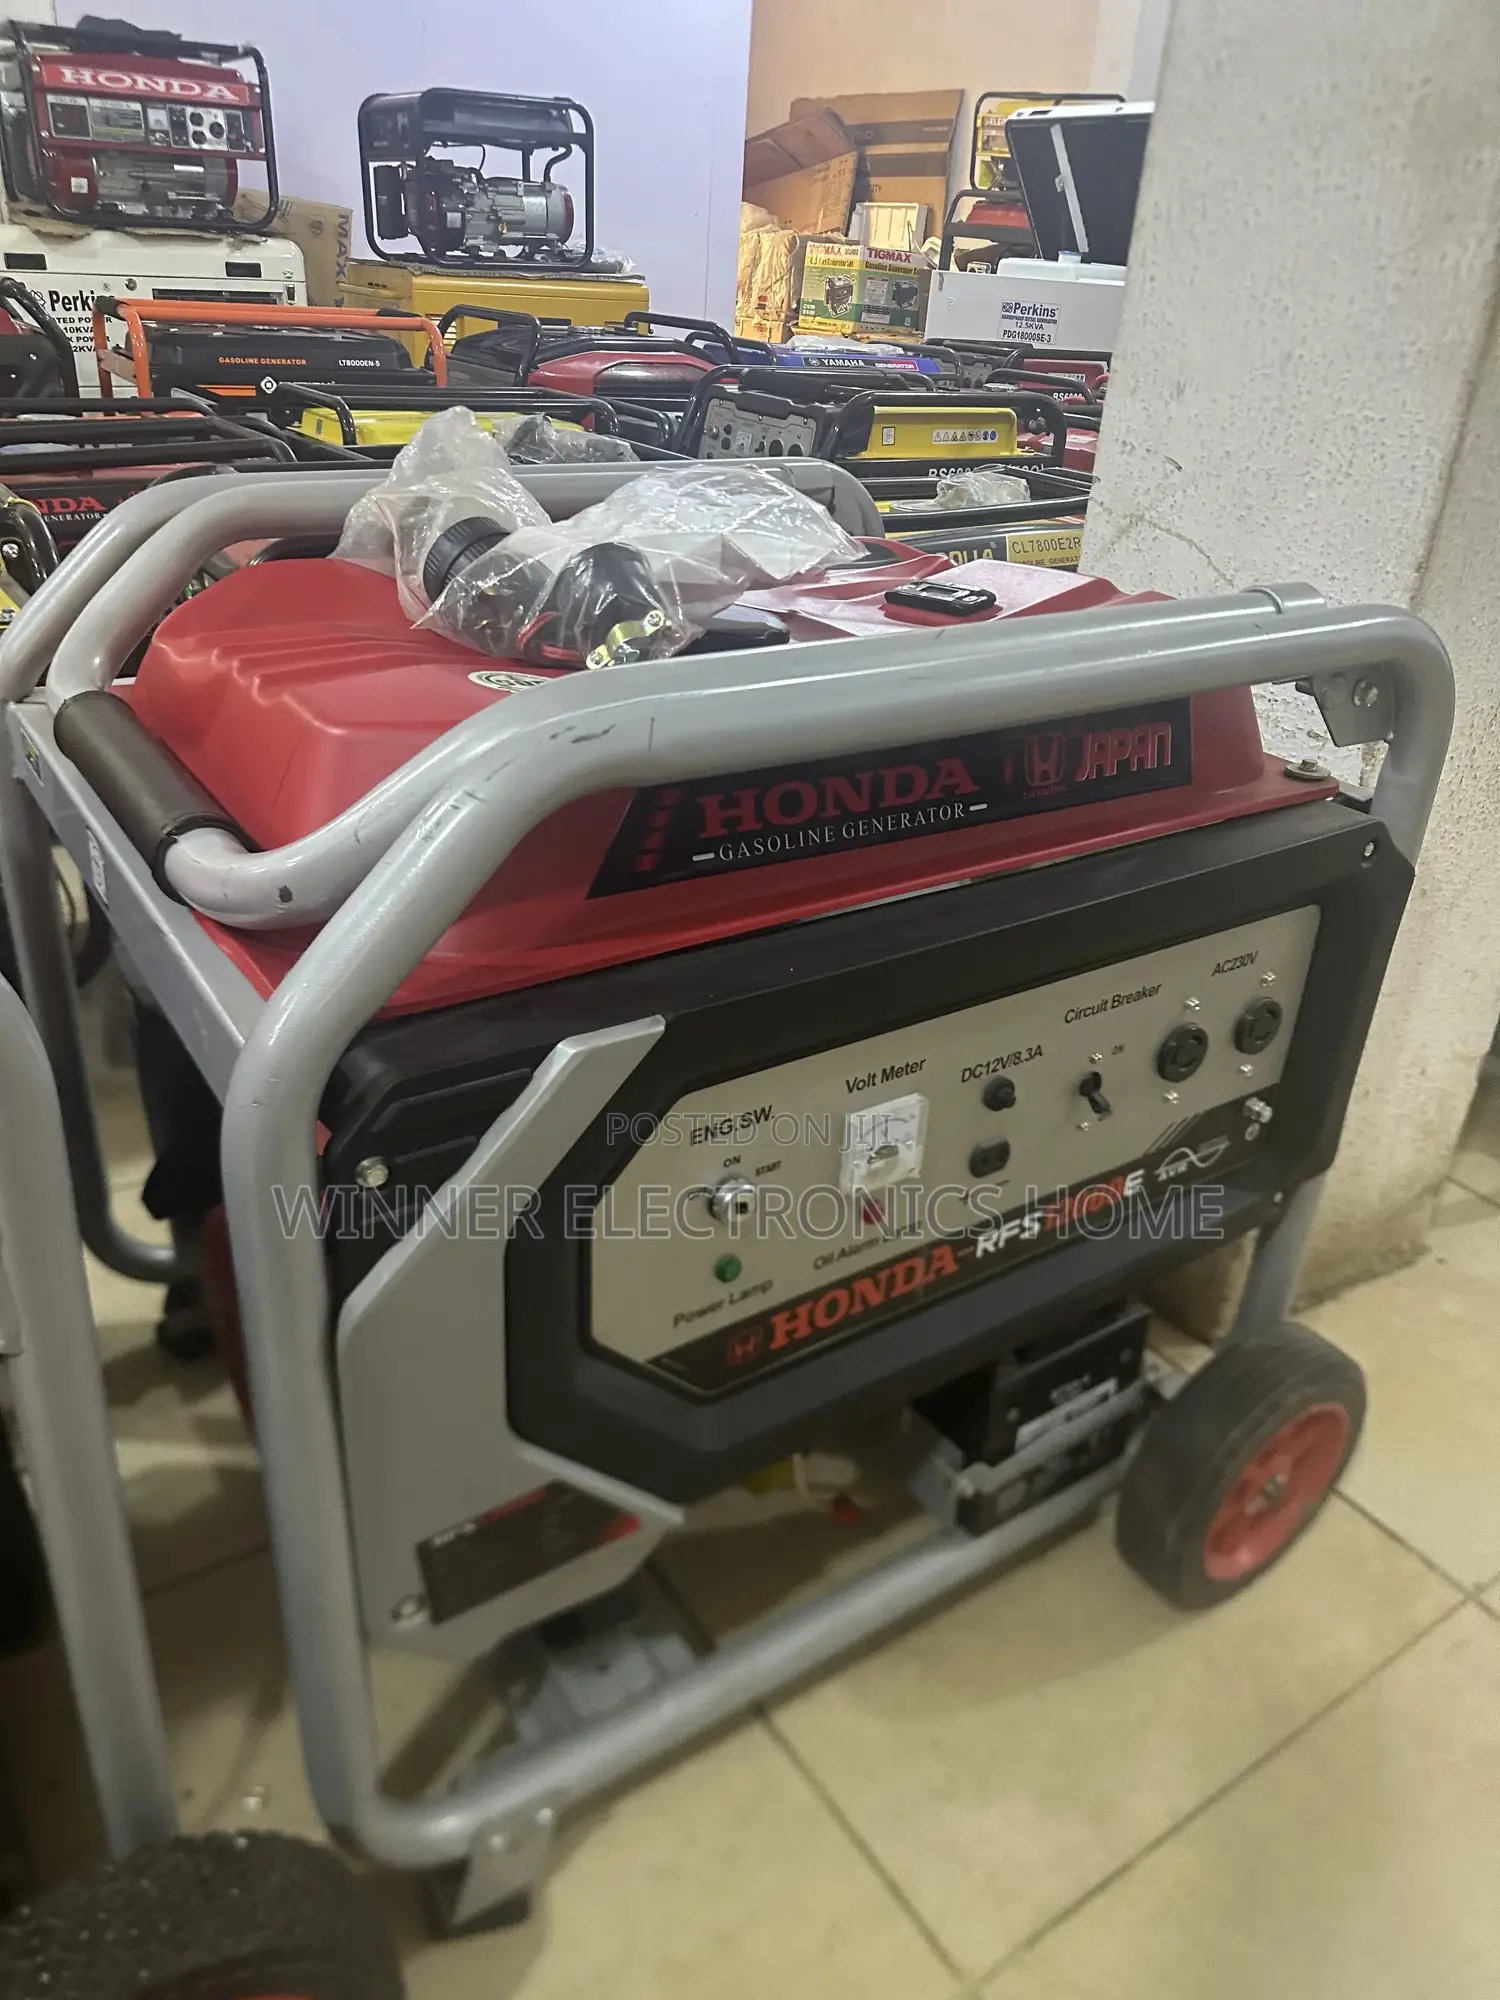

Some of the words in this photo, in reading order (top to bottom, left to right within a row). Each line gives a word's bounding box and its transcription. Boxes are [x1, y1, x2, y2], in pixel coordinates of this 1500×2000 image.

[60, 68, 240, 101] HONDA
[867, 247, 911, 263] TIGMAX
[1013, 302, 1056, 318] Perkins
[1002, 330, 1051, 342] PDG18000SE-3
[1075, 720, 1172, 782] JAPAN
[697, 756, 981, 839] HONDA
[718, 824, 836, 862] GASOLINE
[842, 802, 966, 840] GENERATOR
[1211, 950, 1260, 978] AC230V
[1064, 998, 1109, 1024] Circuit
[1110, 982, 1163, 1010] Breaker
[845, 1070, 877, 1094] Volt
[880, 1058, 927, 1084] Meter
[961, 1044, 1044, 1084] DC12V/8.3A
[689, 1105, 776, 1147] ENG.SW.
[723, 1154, 742, 1168] ON
[672, 1298, 726, 1330] Power
[728, 1279, 774, 1306] Lamp
[769, 1243, 959, 1350] HONDA
